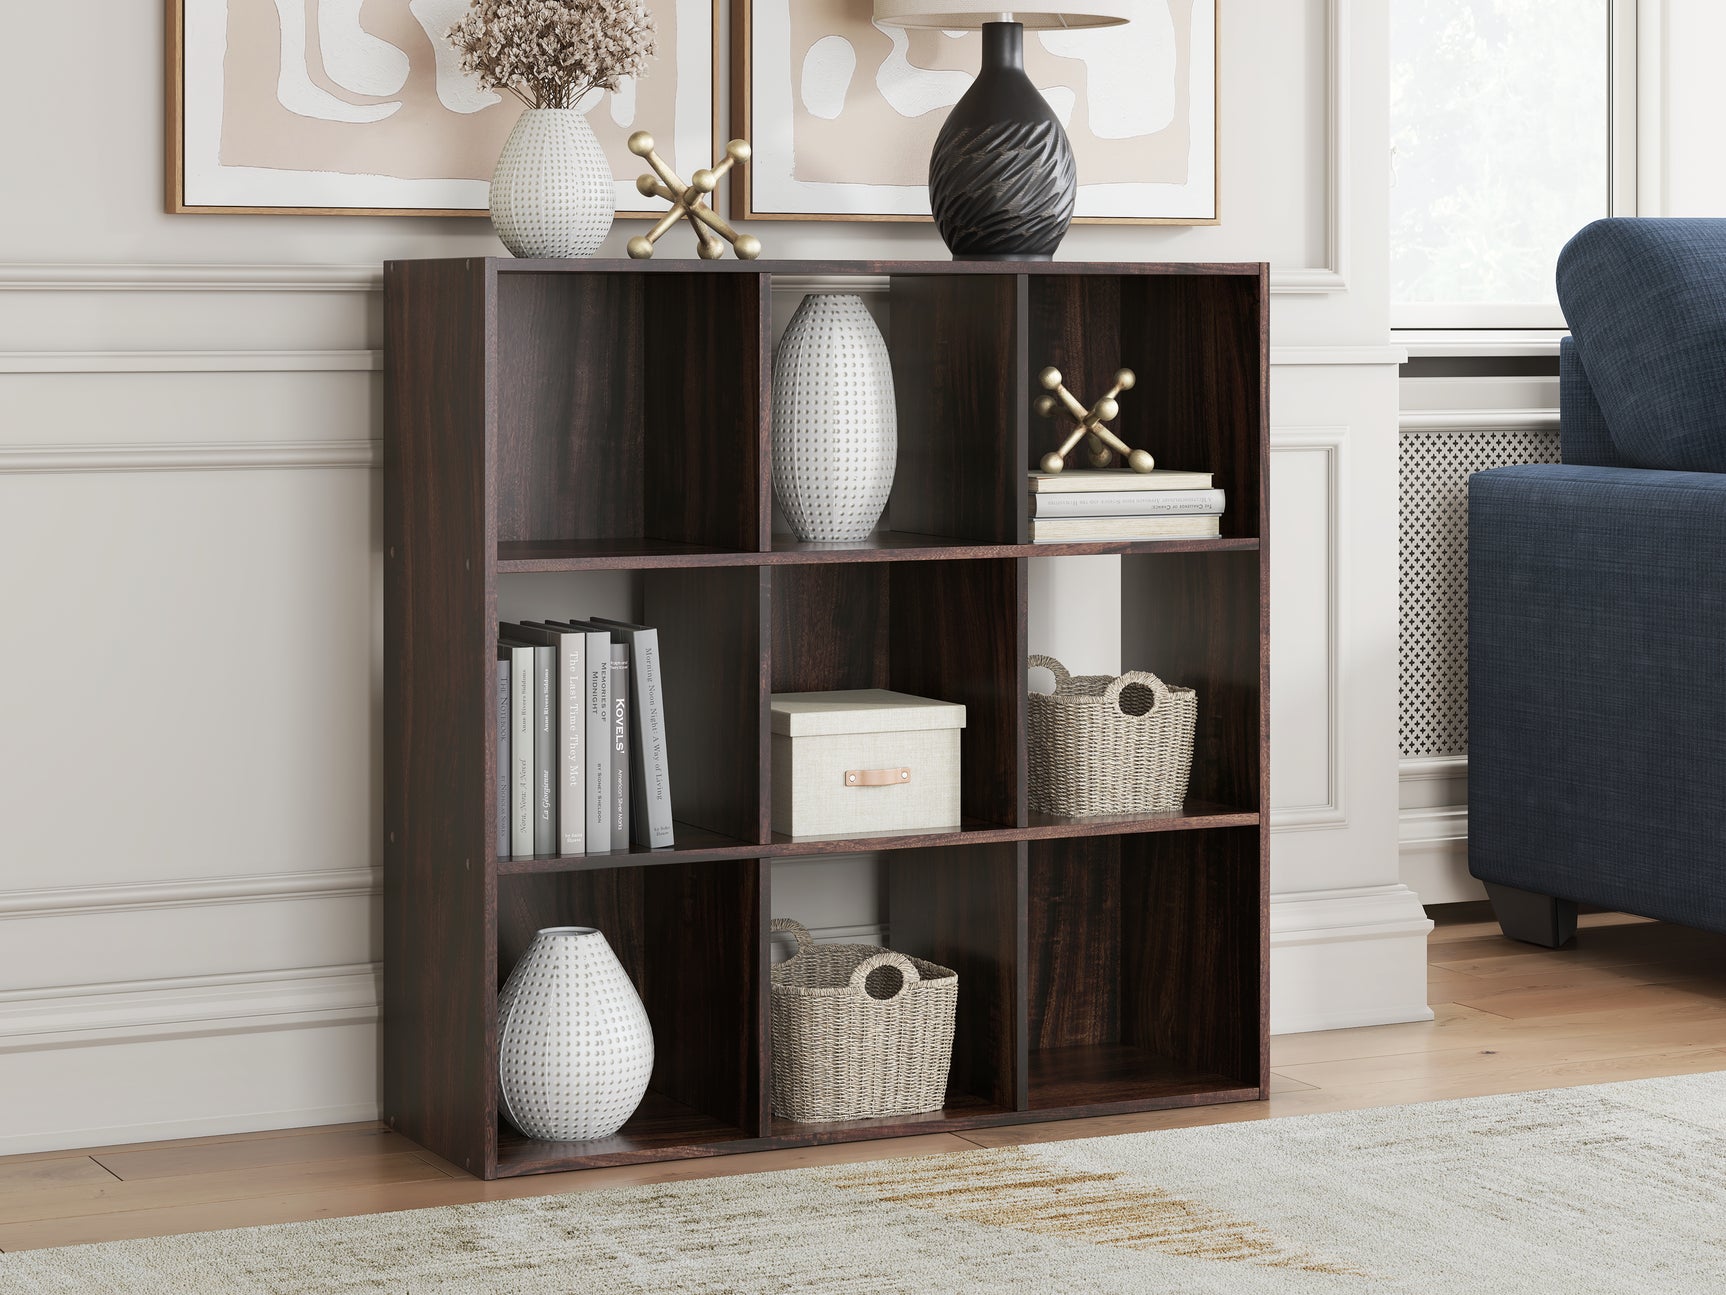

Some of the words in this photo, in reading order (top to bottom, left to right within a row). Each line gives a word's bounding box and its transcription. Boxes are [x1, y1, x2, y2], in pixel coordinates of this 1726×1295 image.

[570, 651, 579, 672] The
[570, 676, 578, 700] Last
[570, 703, 579, 731] Time
[602, 711, 606, 722] OF
[616, 698, 625, 754] KOVELS'
[568, 734, 579, 762] They
[570, 766, 579, 786] Met
[655, 764, 662, 772] of
